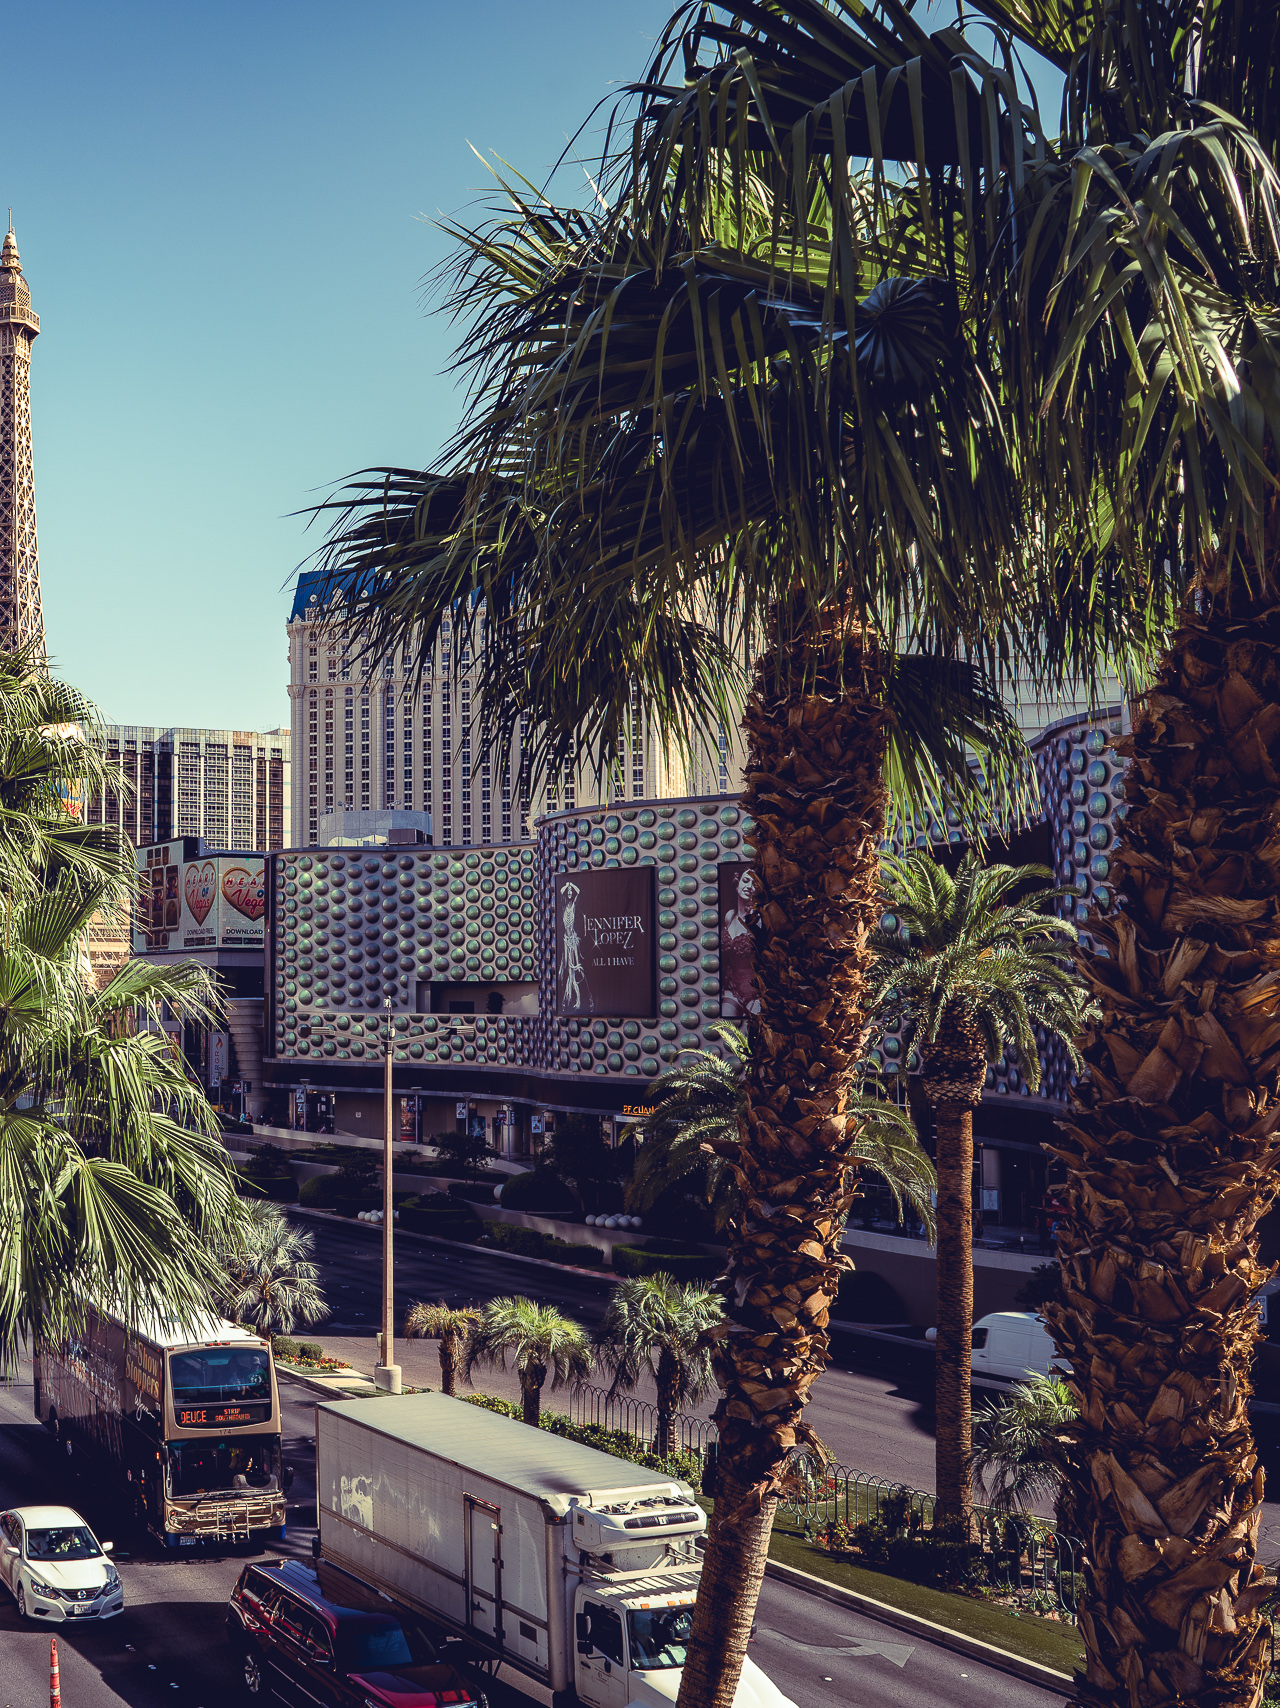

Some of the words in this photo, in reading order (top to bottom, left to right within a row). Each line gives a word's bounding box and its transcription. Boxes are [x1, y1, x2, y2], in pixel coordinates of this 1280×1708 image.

[231, 888, 265, 915] Vega
[583, 914, 644, 936] JENNIFER
[593, 929, 634, 949] LOPEZ
[592, 958, 606, 966] ALL
[613, 957, 634, 966] HAVE
[137, 1342, 159, 1377] Show
[125, 1353, 160, 1399] Stoppers
[180, 1410, 207, 1424] DEUCE
[223, 1407, 241, 1415] STRIP
[214, 1413, 251, 1422] SOUTHBOUND
